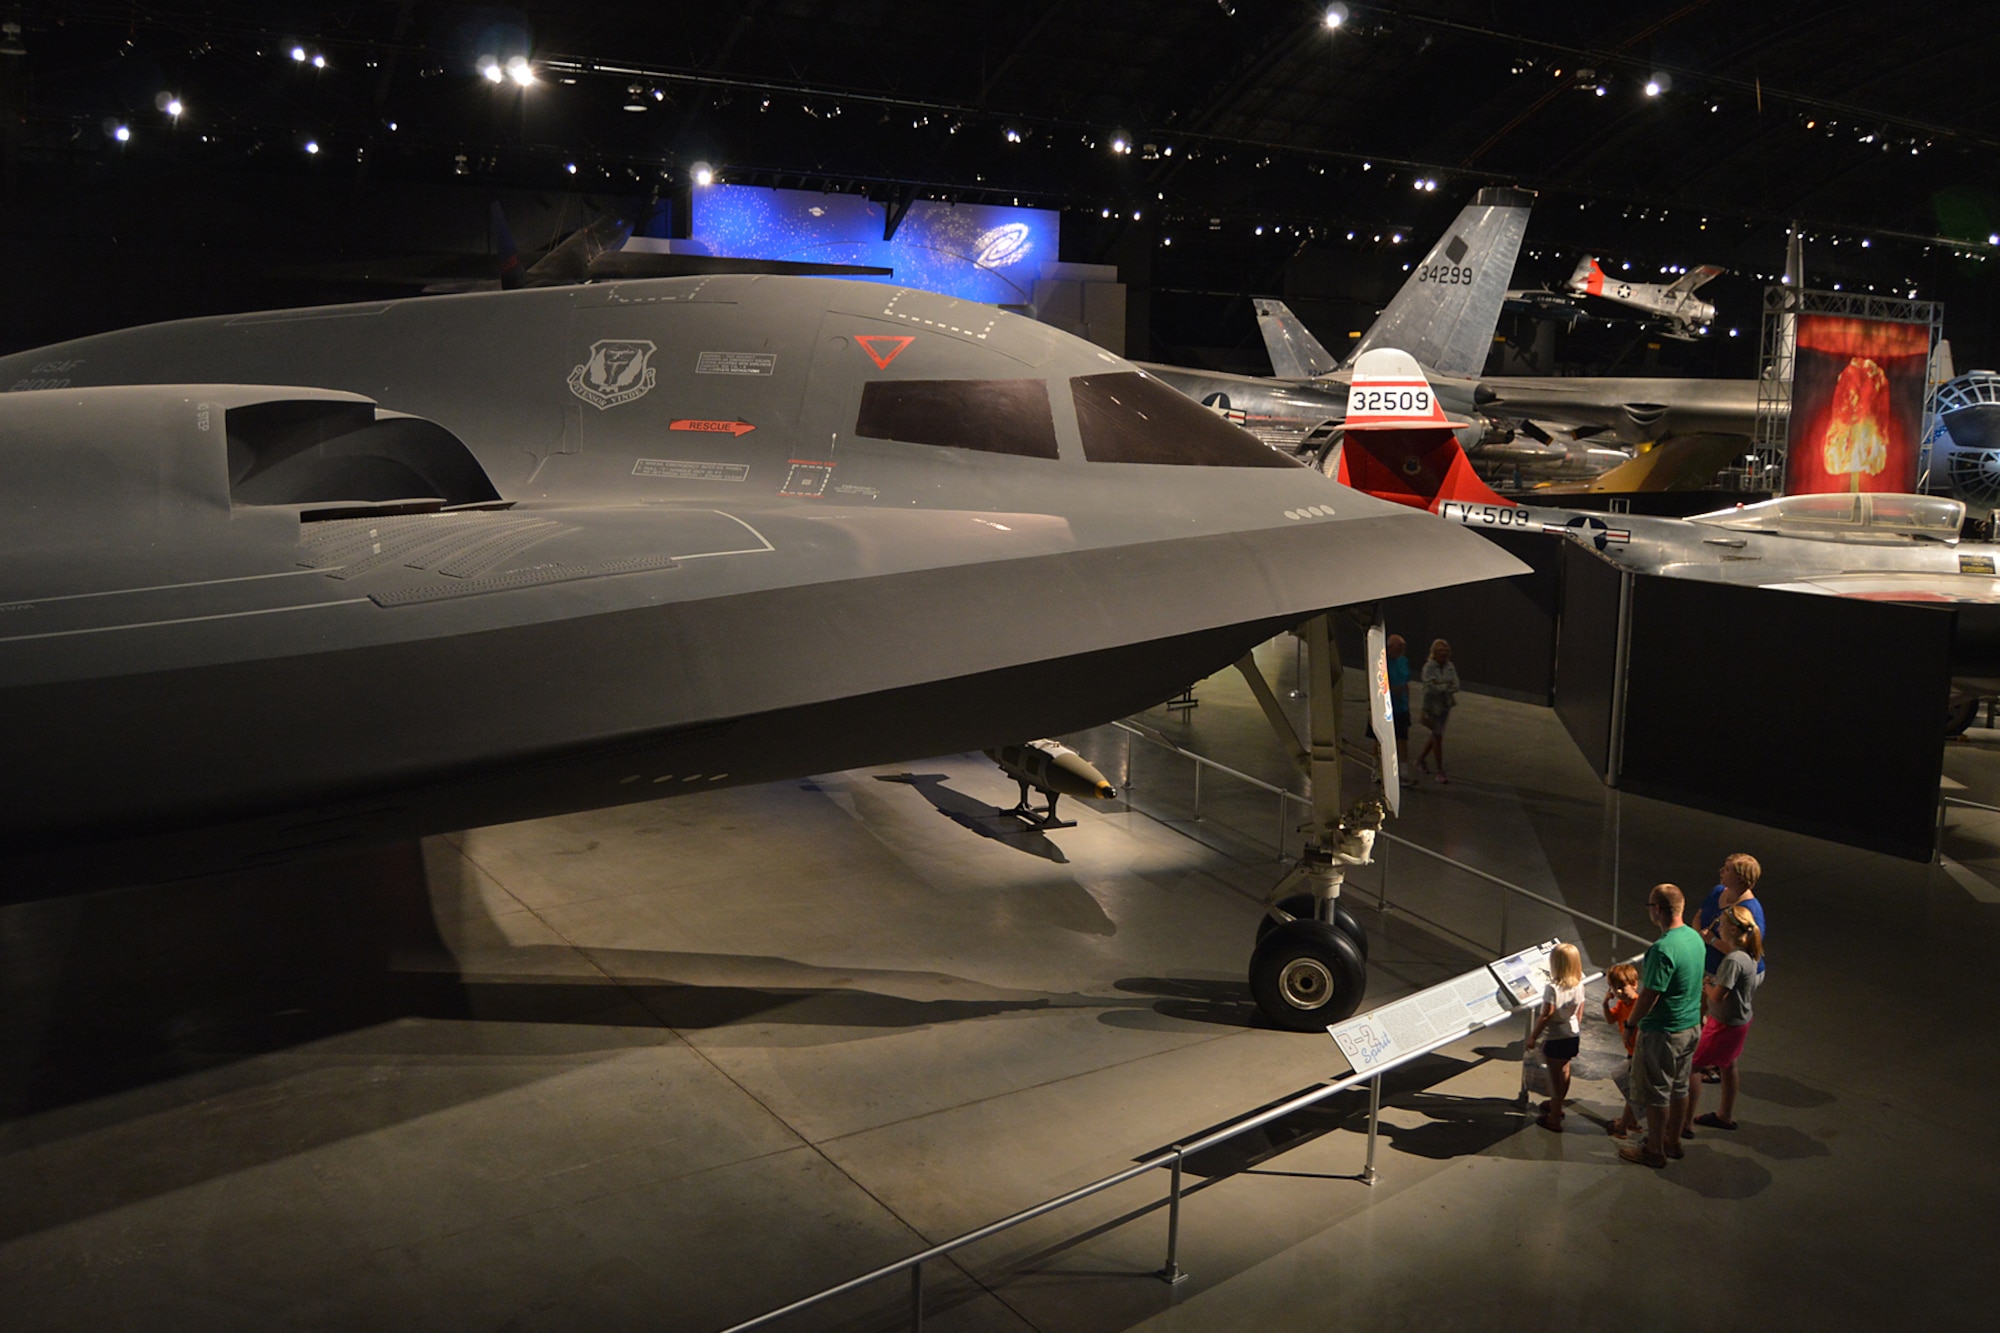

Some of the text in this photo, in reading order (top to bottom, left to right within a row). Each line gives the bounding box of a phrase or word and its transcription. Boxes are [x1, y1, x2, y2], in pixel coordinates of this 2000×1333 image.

[1418, 265, 1473, 286] 34299
[32, 359, 86, 373] USAF
[610, 385, 648, 404] VINDEX
[1353, 391, 1429, 411] 32509
[689, 421, 731, 432] RESCUE
[1337, 1024, 1381, 1057] B-2
[1361, 1031, 1392, 1064] Spirit
